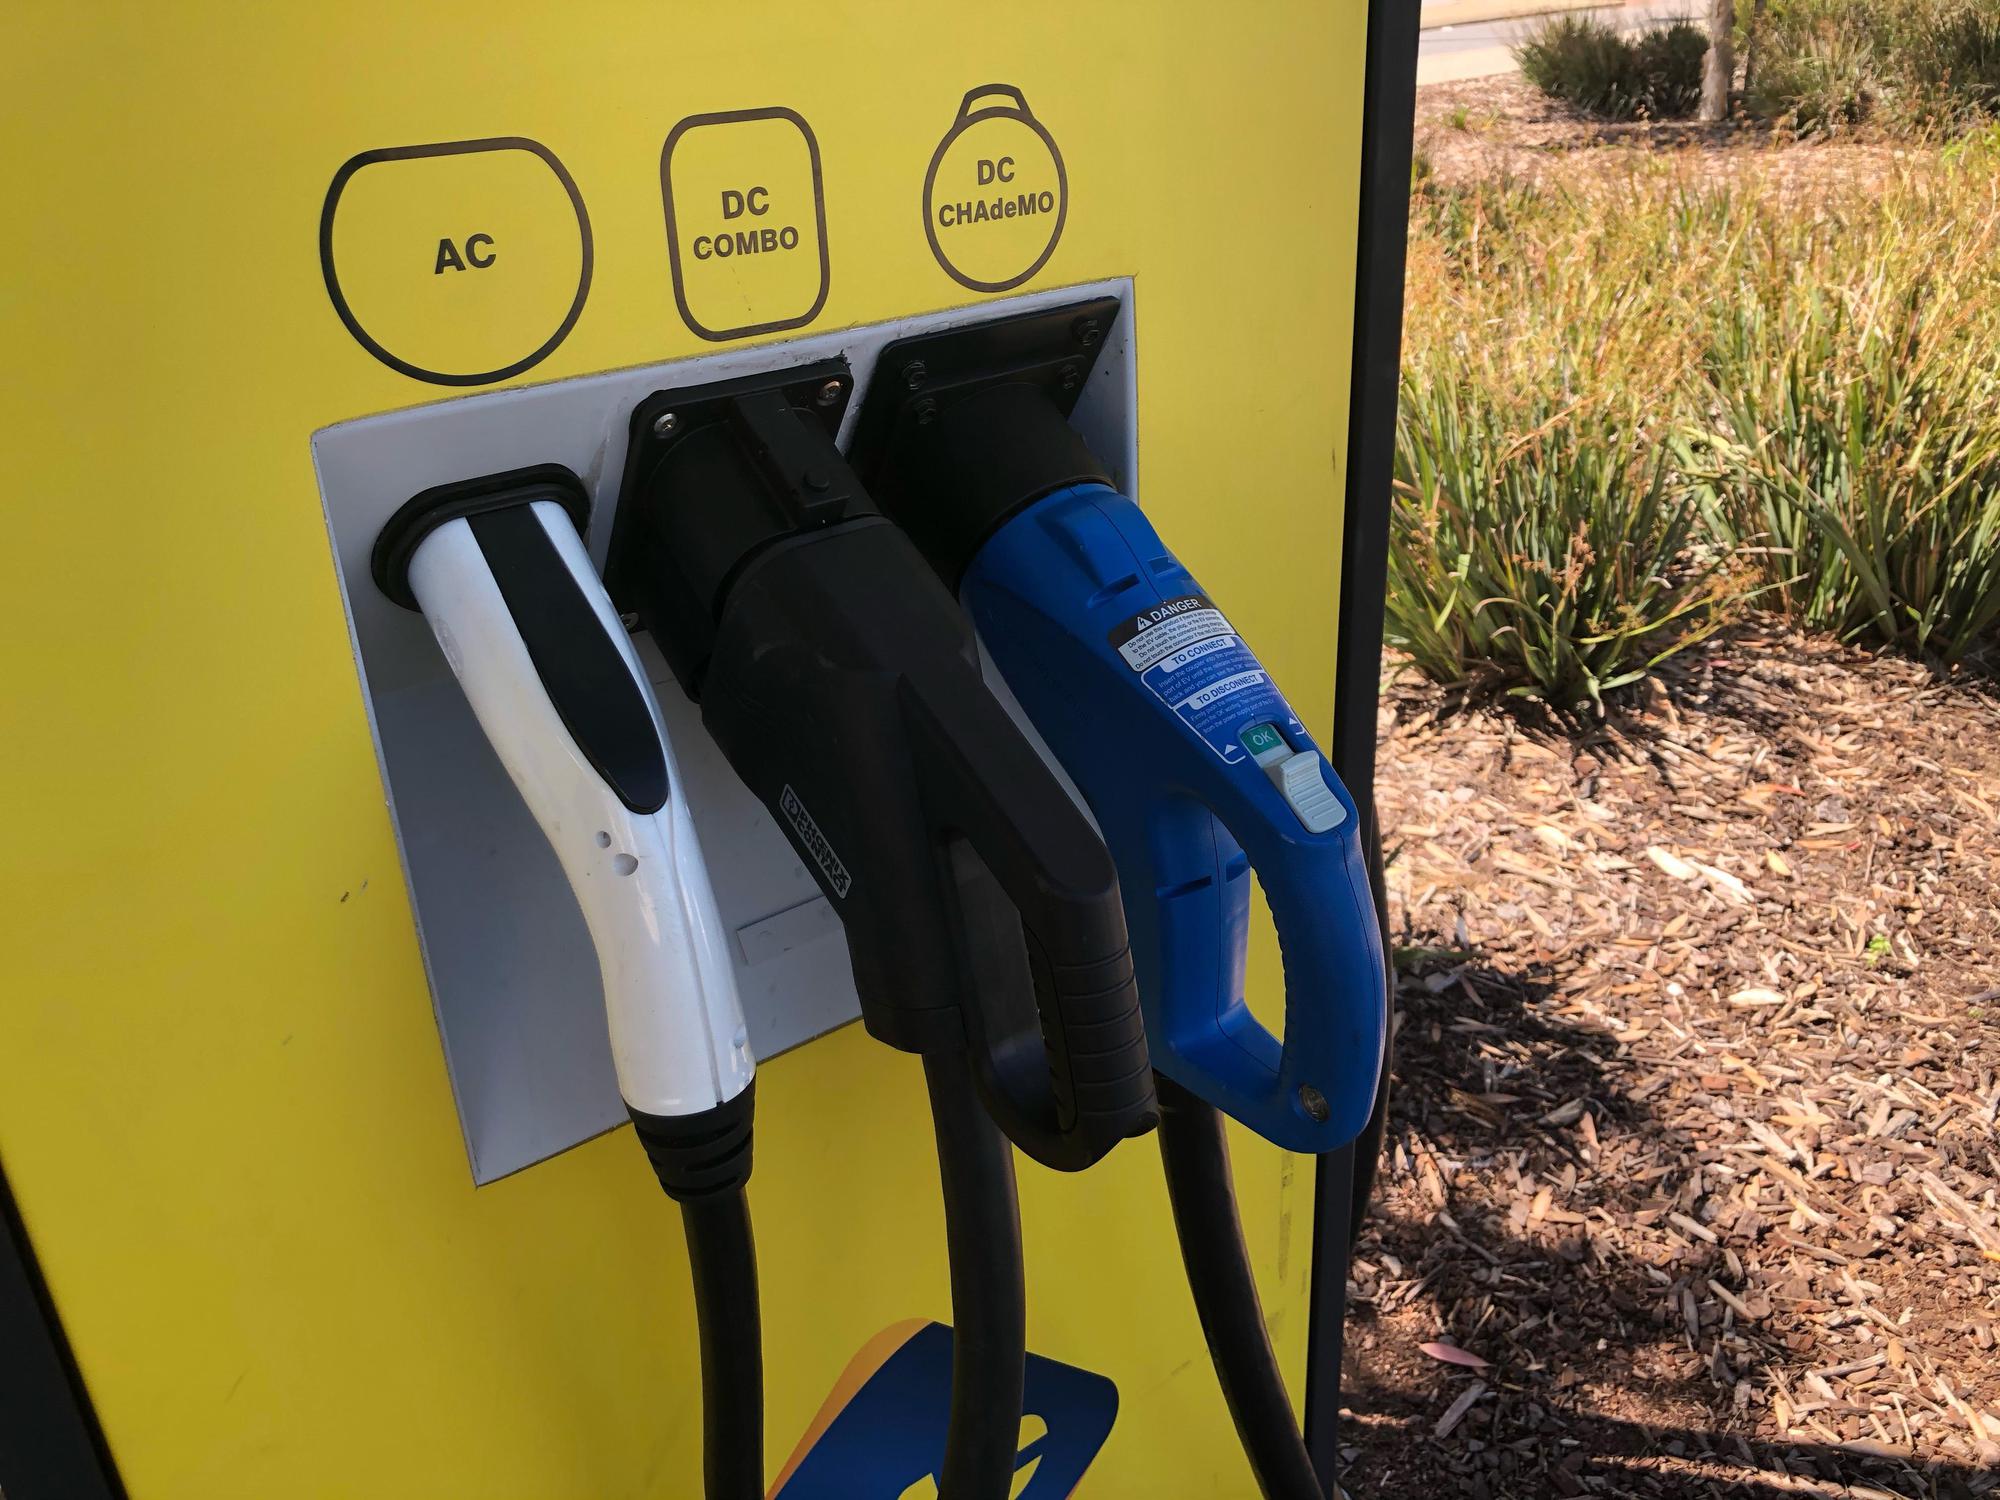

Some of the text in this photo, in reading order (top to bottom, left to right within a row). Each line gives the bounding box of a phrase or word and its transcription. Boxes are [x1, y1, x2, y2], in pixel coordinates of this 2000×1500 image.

[977, 156, 1016, 187] DC
[722, 186, 770, 220] DC
[938, 189, 1055, 228] CHAdeMO
[434, 234, 497, 274] AC
[692, 225, 799, 262] COMBO
[1151, 598, 1202, 622] DANGER
[1136, 636, 1144, 645] not
[1144, 630, 1153, 639] use
[1153, 626, 1163, 635] this
[1164, 618, 1179, 630] product
[1138, 642, 1146, 650] the
[1147, 636, 1154, 645] EV
[1139, 650, 1147, 658] Do
[1147, 645, 1155, 653] not
[1156, 638, 1168, 649] touch
[1143, 657, 1151, 665] not
[1151, 649, 1164, 660] touch
[1164, 644, 1172, 652] the
[1172, 634, 1194, 647] connector
[1172, 655, 1186, 665] TO
[1187, 638, 1227, 658] CONNECT
[1159, 676, 1175, 688] Insert
[1175, 670, 1185, 678] the
[1185, 661, 1205, 674] coupler
[1182, 676, 1190, 684] EV
[1197, 675, 1258, 704] TO DISCONNECT
[1252, 730, 1273, 746] OK
